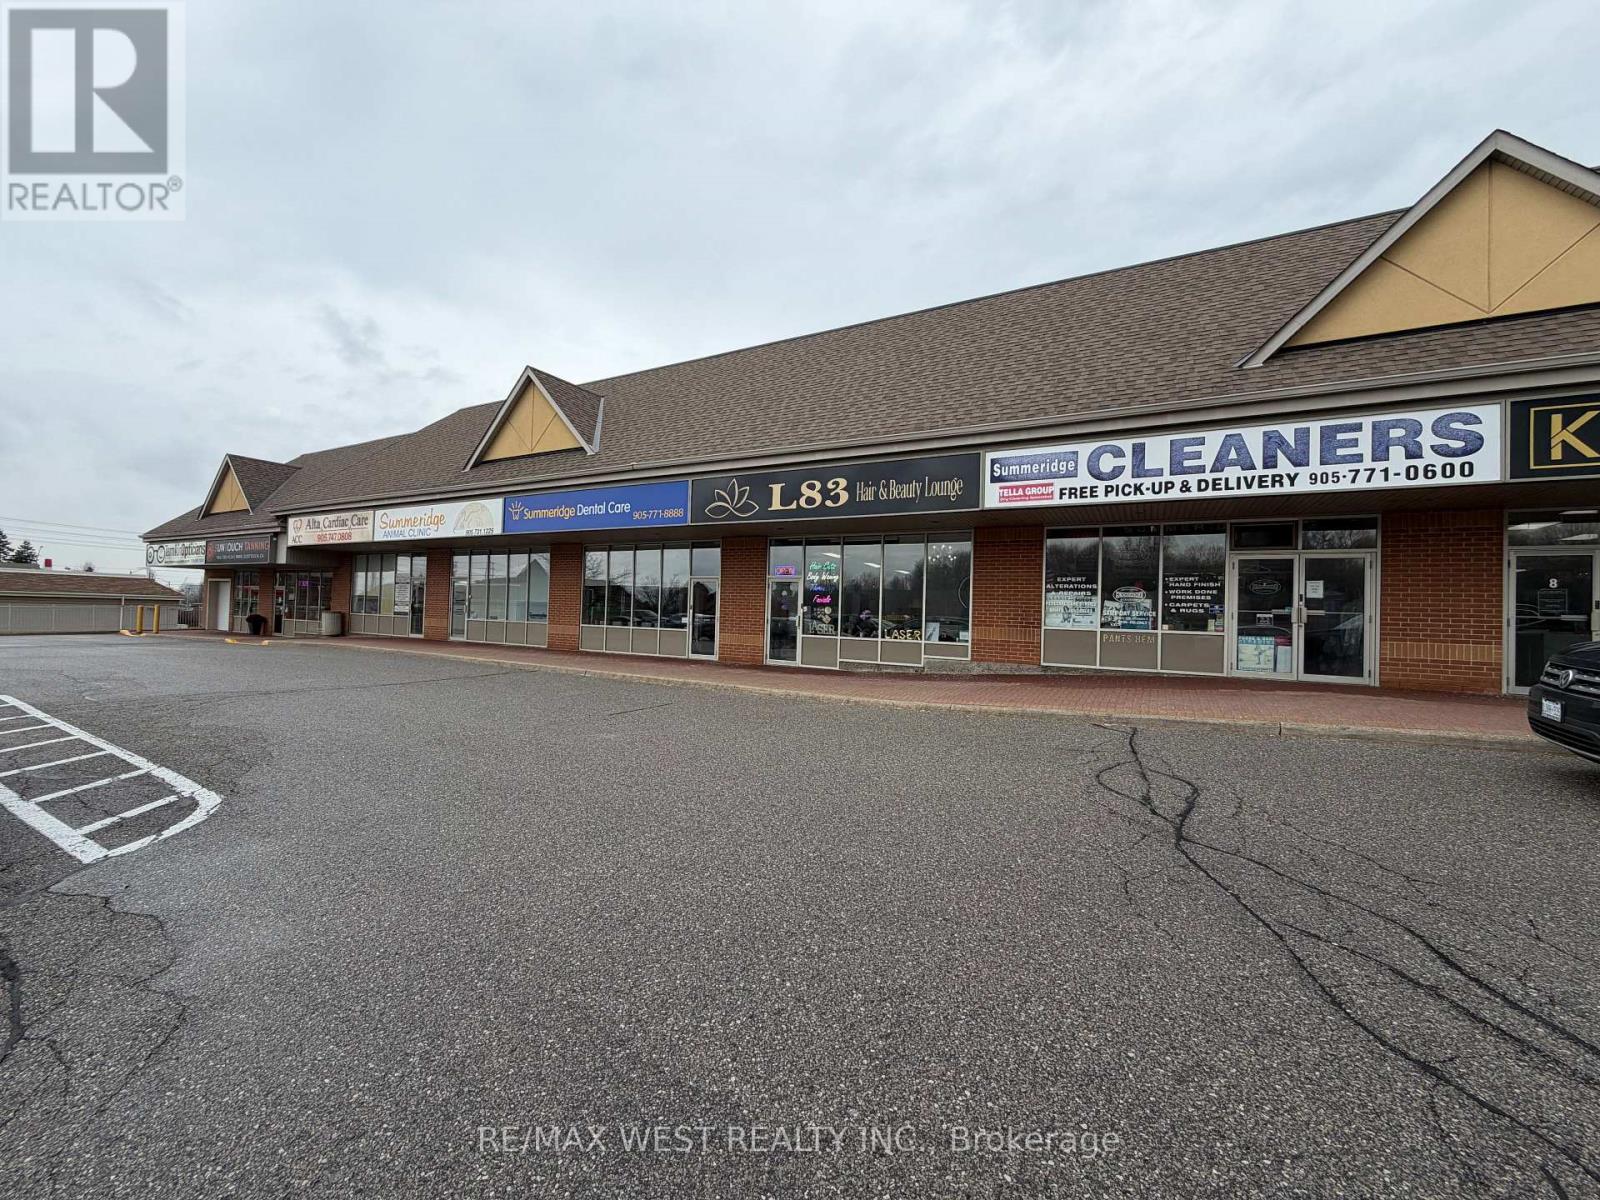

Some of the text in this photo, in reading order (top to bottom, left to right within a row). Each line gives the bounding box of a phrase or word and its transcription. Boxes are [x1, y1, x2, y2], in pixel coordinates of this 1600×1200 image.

[1087, 411, 1485, 481] CLEANERS
[992, 458, 1076, 478] Summeridge
[768, 477, 849, 511] L83
[856, 480, 877, 502] Hair
[924, 476, 964, 501] Lounge
[1025, 485, 1054, 496] GROUP
[1059, 486, 1099, 500] FREE
[1104, 480, 1175, 498] PICK-UP
[1179, 479, 1192, 493] &
[1197, 472, 1300, 492] DELIVERY
[380, 508, 446, 532] Summeridge
[524, 501, 631, 520] Summeridge Dental Care
[305, 513, 368, 530] Alta Cardiac Care
[383, 528, 431, 539] ANIMAL CLINIC
[1549, 578, 1558, 588] 8
[884, 628, 921, 641] LASER
